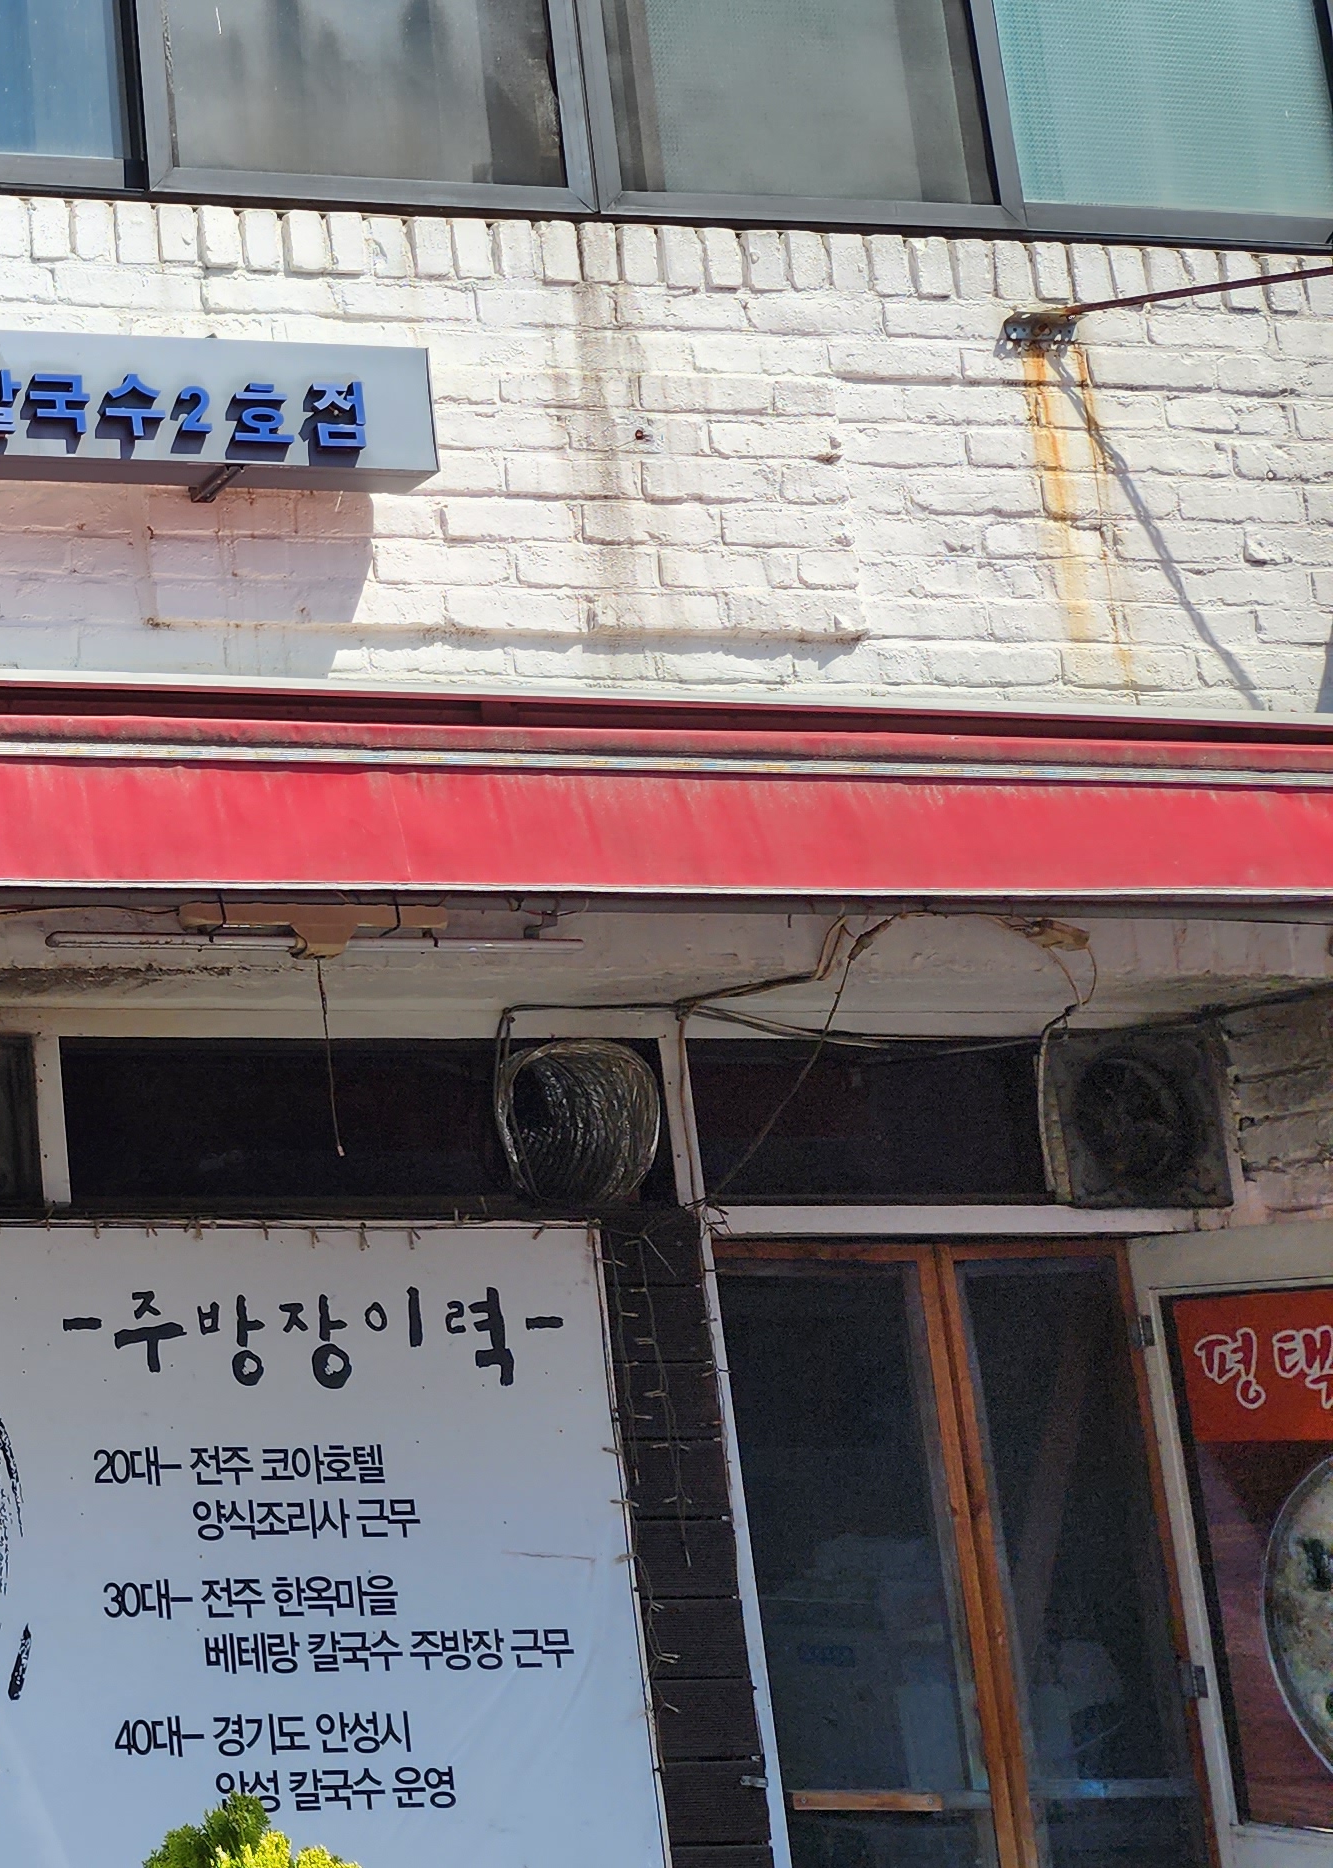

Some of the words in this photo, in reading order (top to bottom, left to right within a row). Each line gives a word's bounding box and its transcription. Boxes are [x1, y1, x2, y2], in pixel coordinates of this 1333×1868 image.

[93, 1445, 182, 1486] 20대-
[189, 1445, 254, 1486] 전주
[261, 1443, 386, 1485] 코아호텔
[191, 1498, 352, 1542] 양식조리사
[355, 1498, 422, 1540] 근무
[102, 1578, 194, 1620] 30대-
[200, 1577, 266, 1619] 전주
[271, 1574, 400, 1618] 한옥마을
[203, 1631, 300, 1674] 베테랑
[306, 1630, 404, 1673] 칼국수
[408, 1628, 505, 1671] 주방장
[509, 1627, 576, 1669] 근무
[113, 1714, 205, 1758] 40대-
[211, 1712, 311, 1757] 경기도
[314, 1709, 414, 1754] 안성시
[213, 1768, 282, 1814] 안성
[287, 1767, 387, 1813] 칼국수
[390, 1764, 458, 1810] 운영
